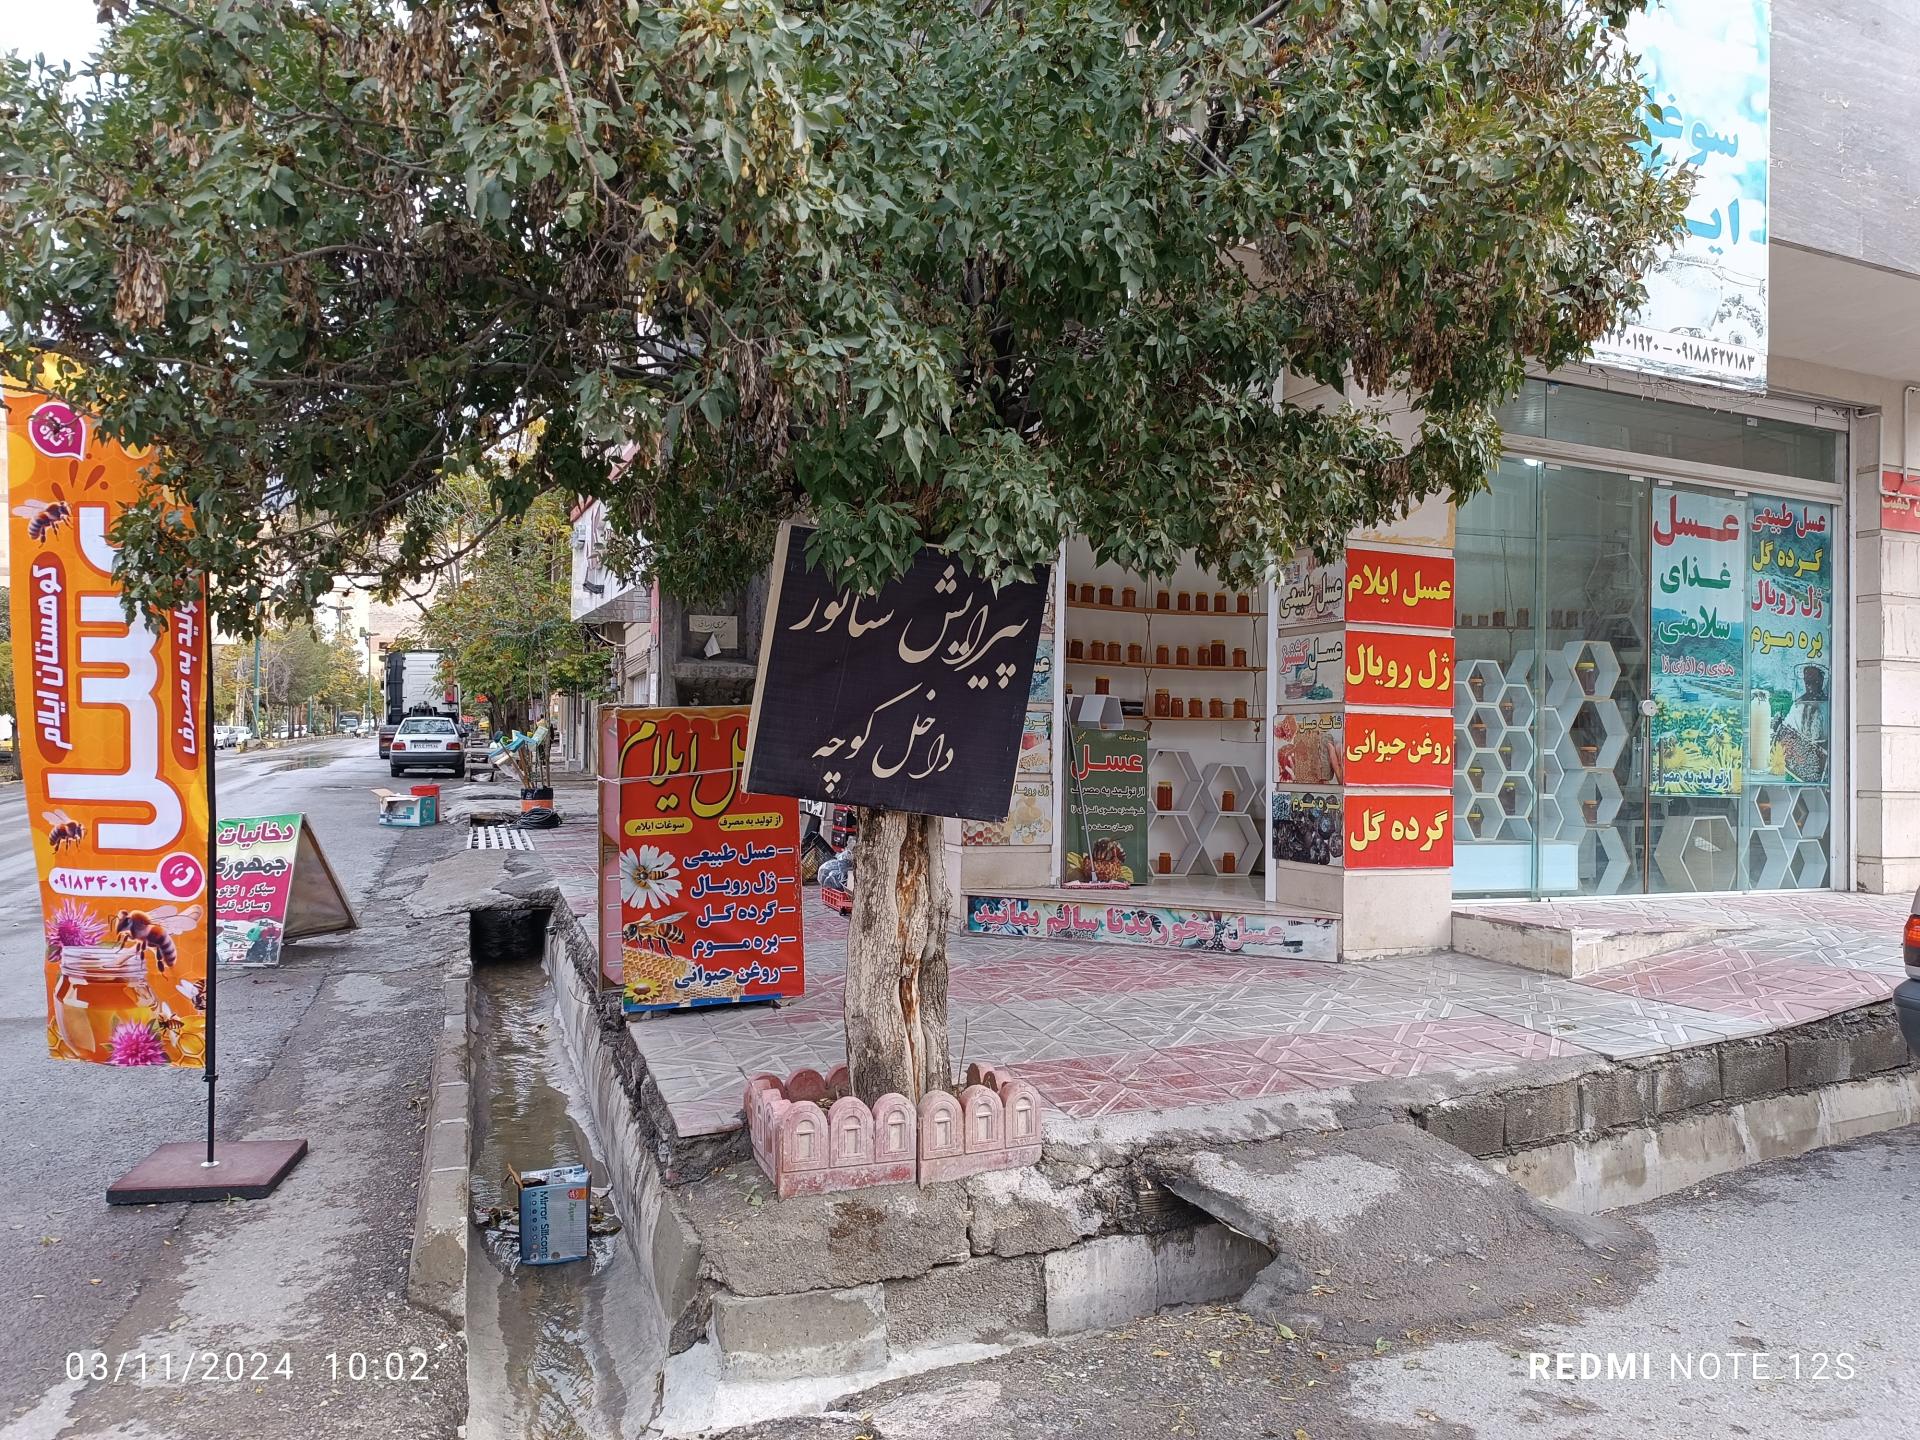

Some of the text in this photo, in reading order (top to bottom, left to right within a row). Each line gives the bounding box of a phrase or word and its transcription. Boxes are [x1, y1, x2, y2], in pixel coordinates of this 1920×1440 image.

[1653, 494, 1740, 547] عسل
[1751, 503, 1826, 538] عسل طبیعی
[1659, 555, 1732, 594] غذای
[1752, 539, 1823, 577] گرده گل
[1280, 571, 1343, 619] عسل طبیعی
[1347, 565, 1452, 608] عسل ایلام
[1751, 578, 1823, 620] ژل رویال
[898, 564, 1029, 689] پیرایش
[1658, 605, 1731, 646] سلامتی
[1750, 625, 1823, 659] بره موم
[33, 564, 73, 750] کوهستان ایلام
[178, 651, 198, 675] به
[1308, 637, 1343, 671] عسل
[1345, 643, 1451, 692] ژل رویال
[177, 679, 196, 755] مصرف
[871, 688, 954, 780] داخل
[811, 682, 923, 794] کوچه
[1346, 728, 1451, 765] روغن حیوانی
[619, 720, 697, 812] ایلام
[1070, 743, 1144, 781] عسل
[217, 821, 295, 849] دخانیات
[634, 821, 685, 833] سوغات ایلام
[719, 818, 744, 830] مصرف
[754, 815, 773, 828] تولید
[774, 815, 781, 827] از
[1349, 807, 1449, 852] گرده گل
[683, 842, 738, 869] طبیعی
[54, 872, 158, 893] ۰۹۱۸۳۴۰۱۹۲۰
[690, 874, 750, 899] رویال
[696, 903, 735, 928] گل
[973, 897, 1041, 936] بمانید
[1045, 900, 1102, 938] سالم
[692, 936, 751, 959] موم
[1223, 917, 1286, 953] عسل
[673, 964, 735, 991] حیوانی
[540, 1190, 549, 1221] Mirror
